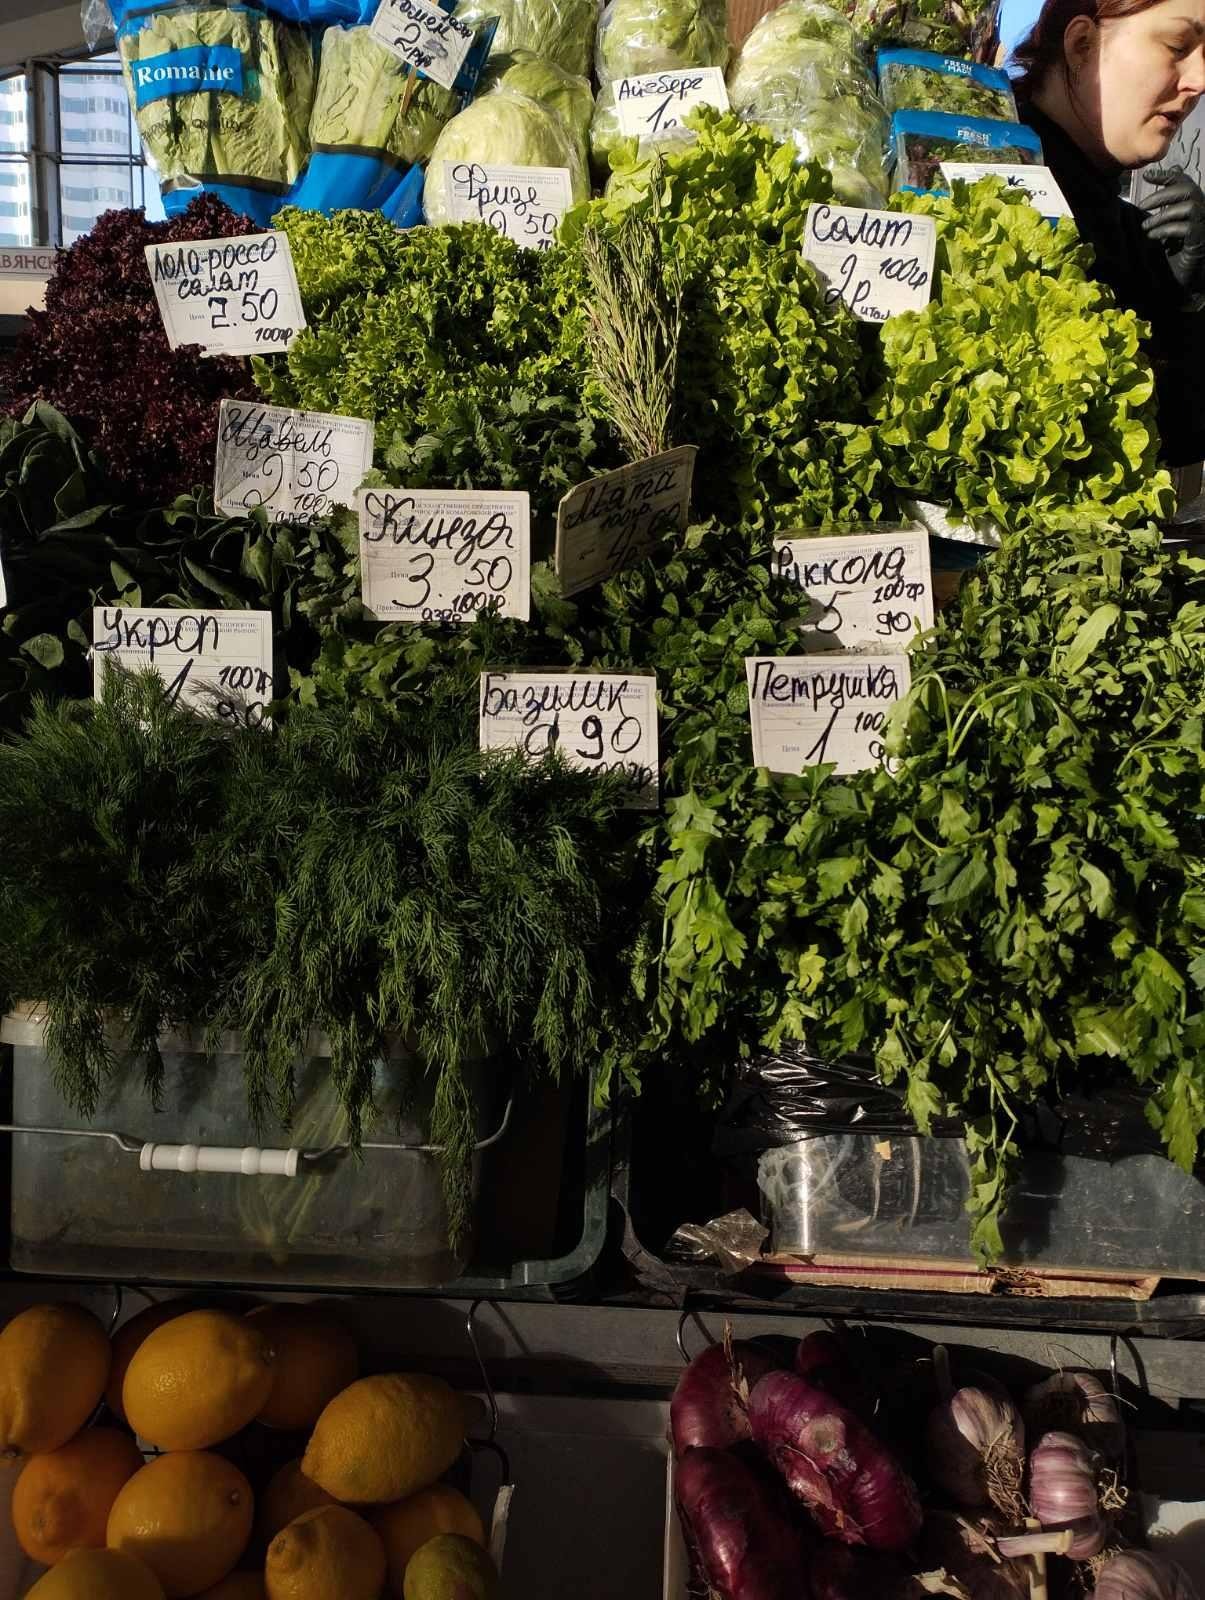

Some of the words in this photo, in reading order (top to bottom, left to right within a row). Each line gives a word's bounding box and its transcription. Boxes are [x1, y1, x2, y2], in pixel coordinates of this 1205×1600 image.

[390, 0, 450, 41] омен
[452, 163, 540, 217] Фризе
[812, 205, 912, 248] Салат
[221, 408, 333, 461] Щавель
[363, 492, 514, 566] Кинза
[94, 609, 218, 662] Укроп
[752, 661, 898, 712] Петрушка
